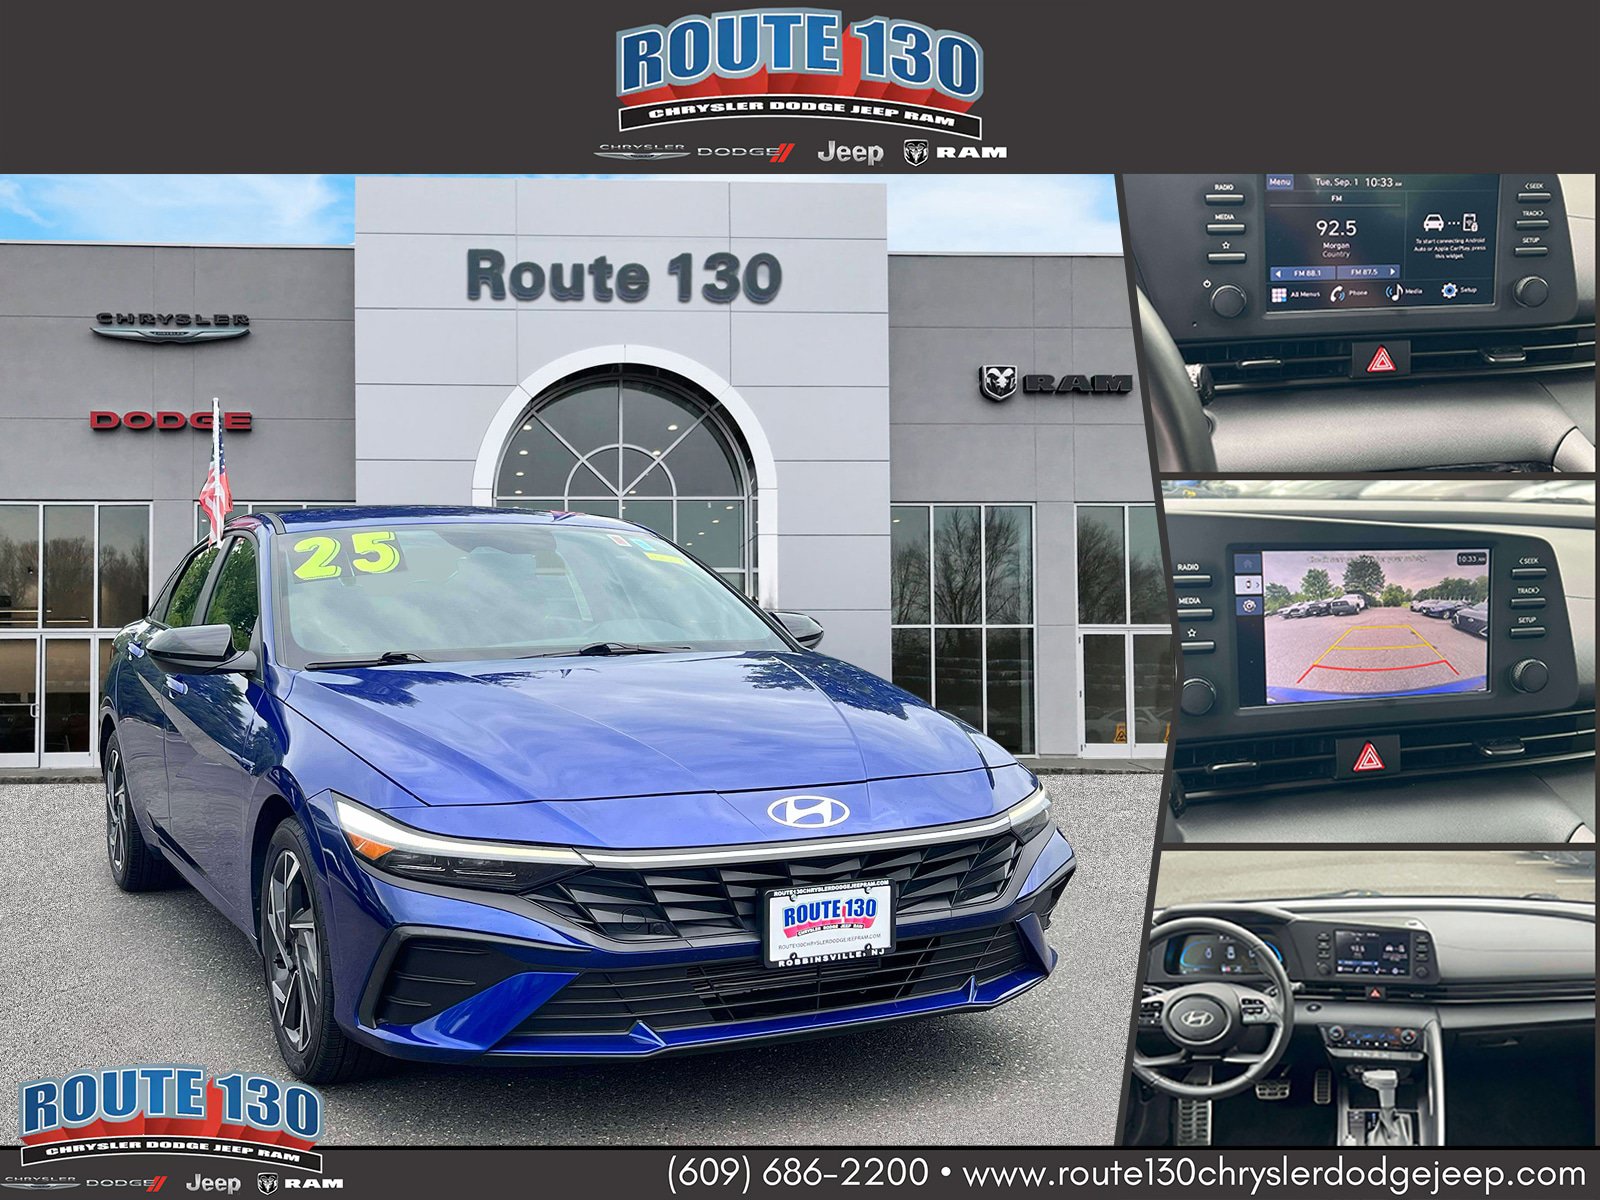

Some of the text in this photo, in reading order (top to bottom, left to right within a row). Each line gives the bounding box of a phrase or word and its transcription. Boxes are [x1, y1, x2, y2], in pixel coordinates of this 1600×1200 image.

[1269, 178, 1292, 187] Menu
[1354, 178, 1358, 186] 1
[1365, 177, 1394, 188] 10:33
[1331, 194, 1343, 202] FM
[1316, 219, 1358, 237] 92.5
[1522, 236, 1541, 244] SETUP
[1322, 241, 1351, 251] Morgan
[1321, 250, 1351, 259] Country
[1363, 268, 1379, 276] 87.5
[467, 249, 783, 305] Route 130
[1300, 289, 1321, 298] Menus
[1460, 286, 1478, 294] Setup
[96, 312, 250, 326] CHRYSLER
[1021, 374, 1134, 395] RAM
[90, 411, 252, 432] DODGE
[293, 531, 401, 582] 25
[1177, 563, 1199, 571] RADIO
[784, 898, 877, 927] ROUTE 130
[871, 948, 885, 956] NJ
